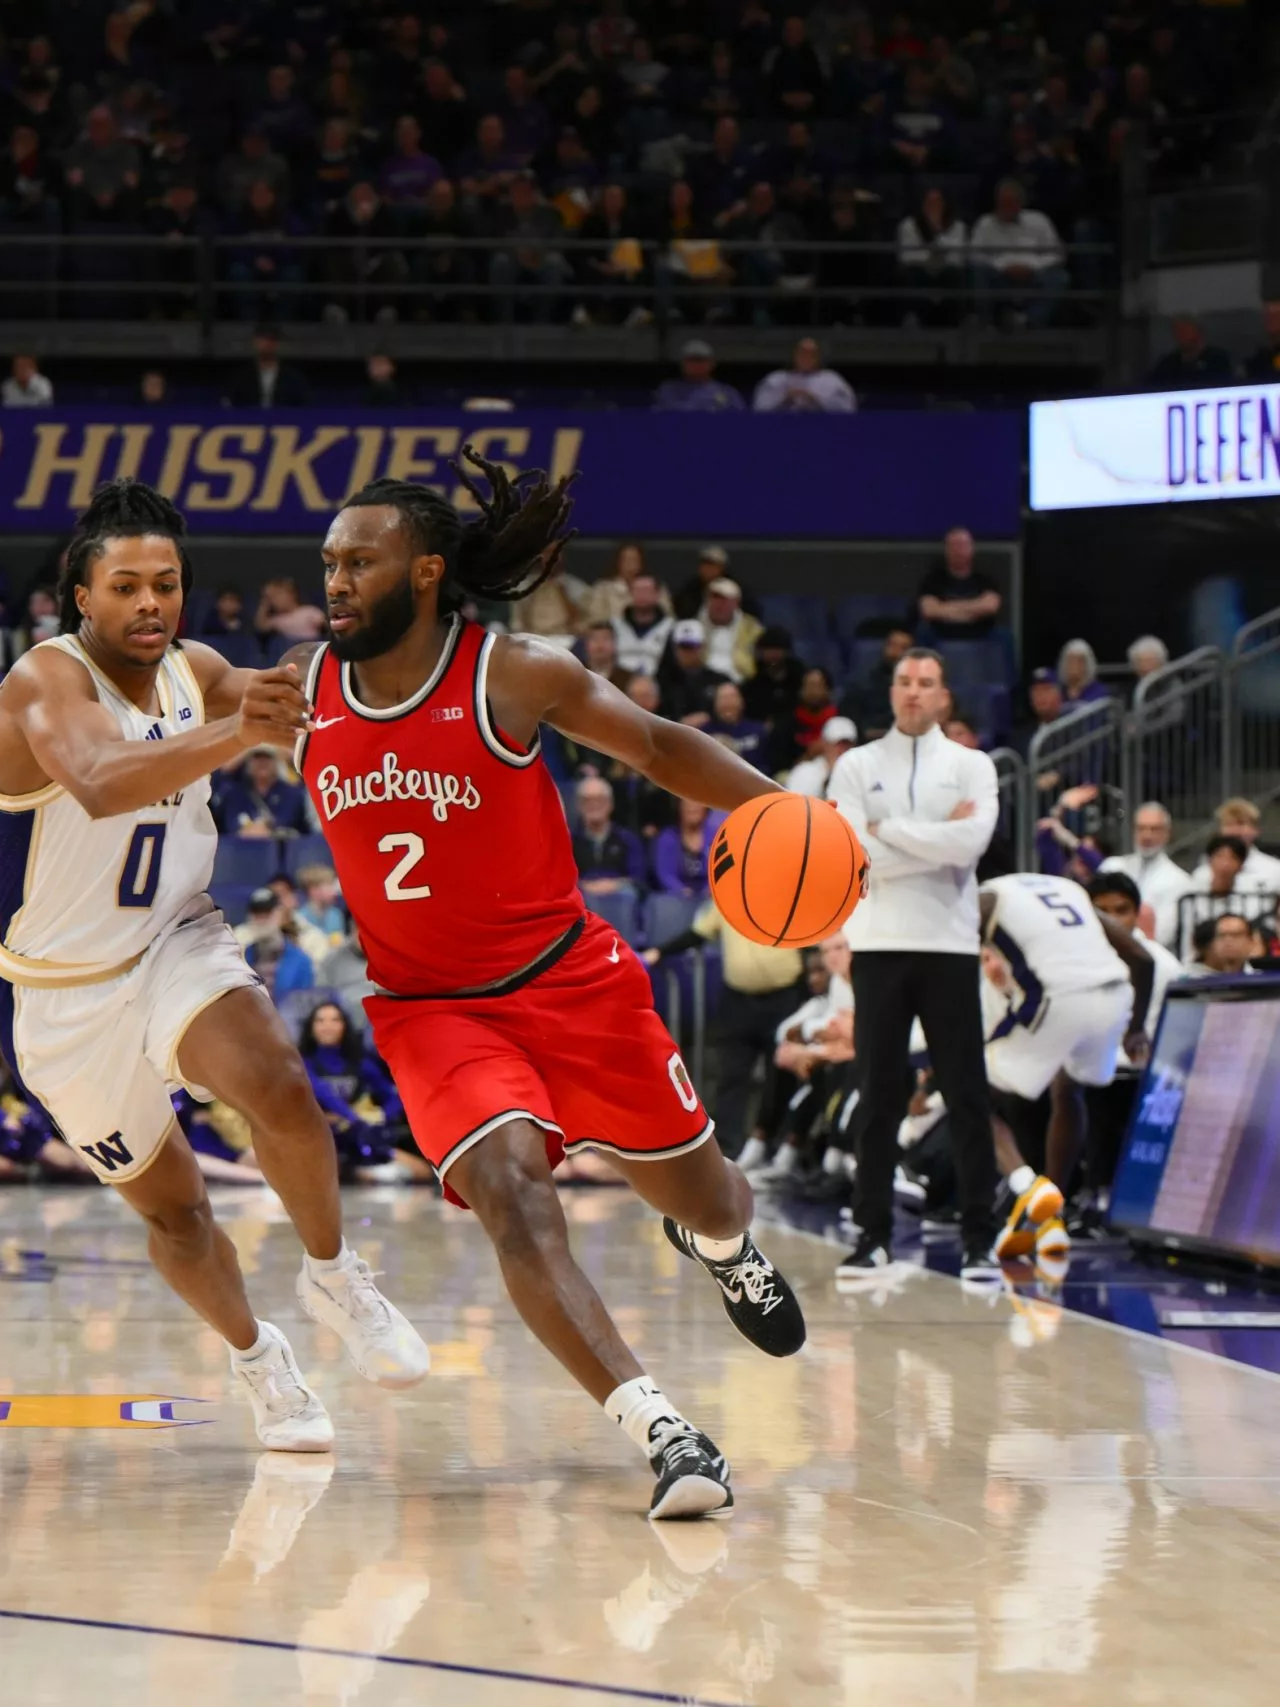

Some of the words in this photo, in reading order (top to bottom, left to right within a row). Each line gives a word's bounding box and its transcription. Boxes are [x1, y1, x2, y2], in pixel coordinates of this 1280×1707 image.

[1167, 397, 1280, 486] DEFEN
[316, 751, 482, 822] Buckeyes
[116, 820, 169, 910] 0
[377, 831, 432, 901] 2
[1037, 892, 1085, 928] 5
[79, 1129, 135, 1172] W
